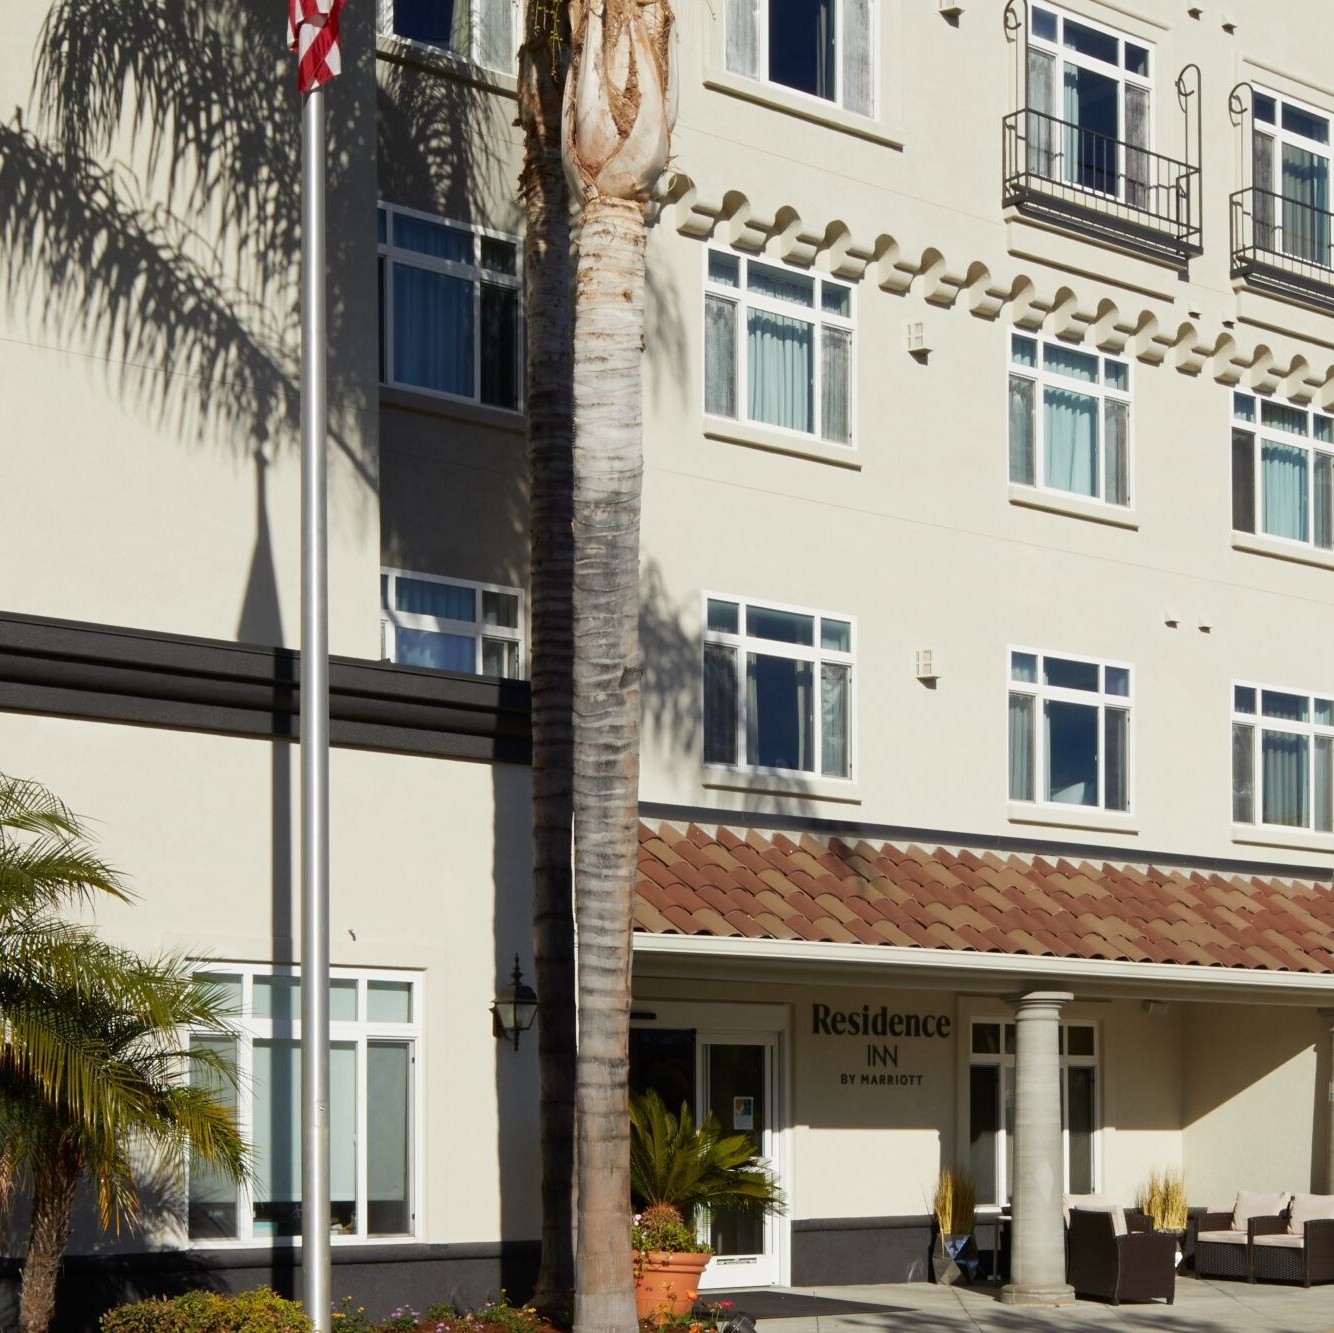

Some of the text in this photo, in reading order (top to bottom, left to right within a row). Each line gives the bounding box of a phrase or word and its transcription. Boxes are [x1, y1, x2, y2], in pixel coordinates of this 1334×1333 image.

[812, 1004, 951, 1038] Residence
[867, 1044, 898, 1067] INN
[841, 1074, 923, 1085] BY MARRIOTT
